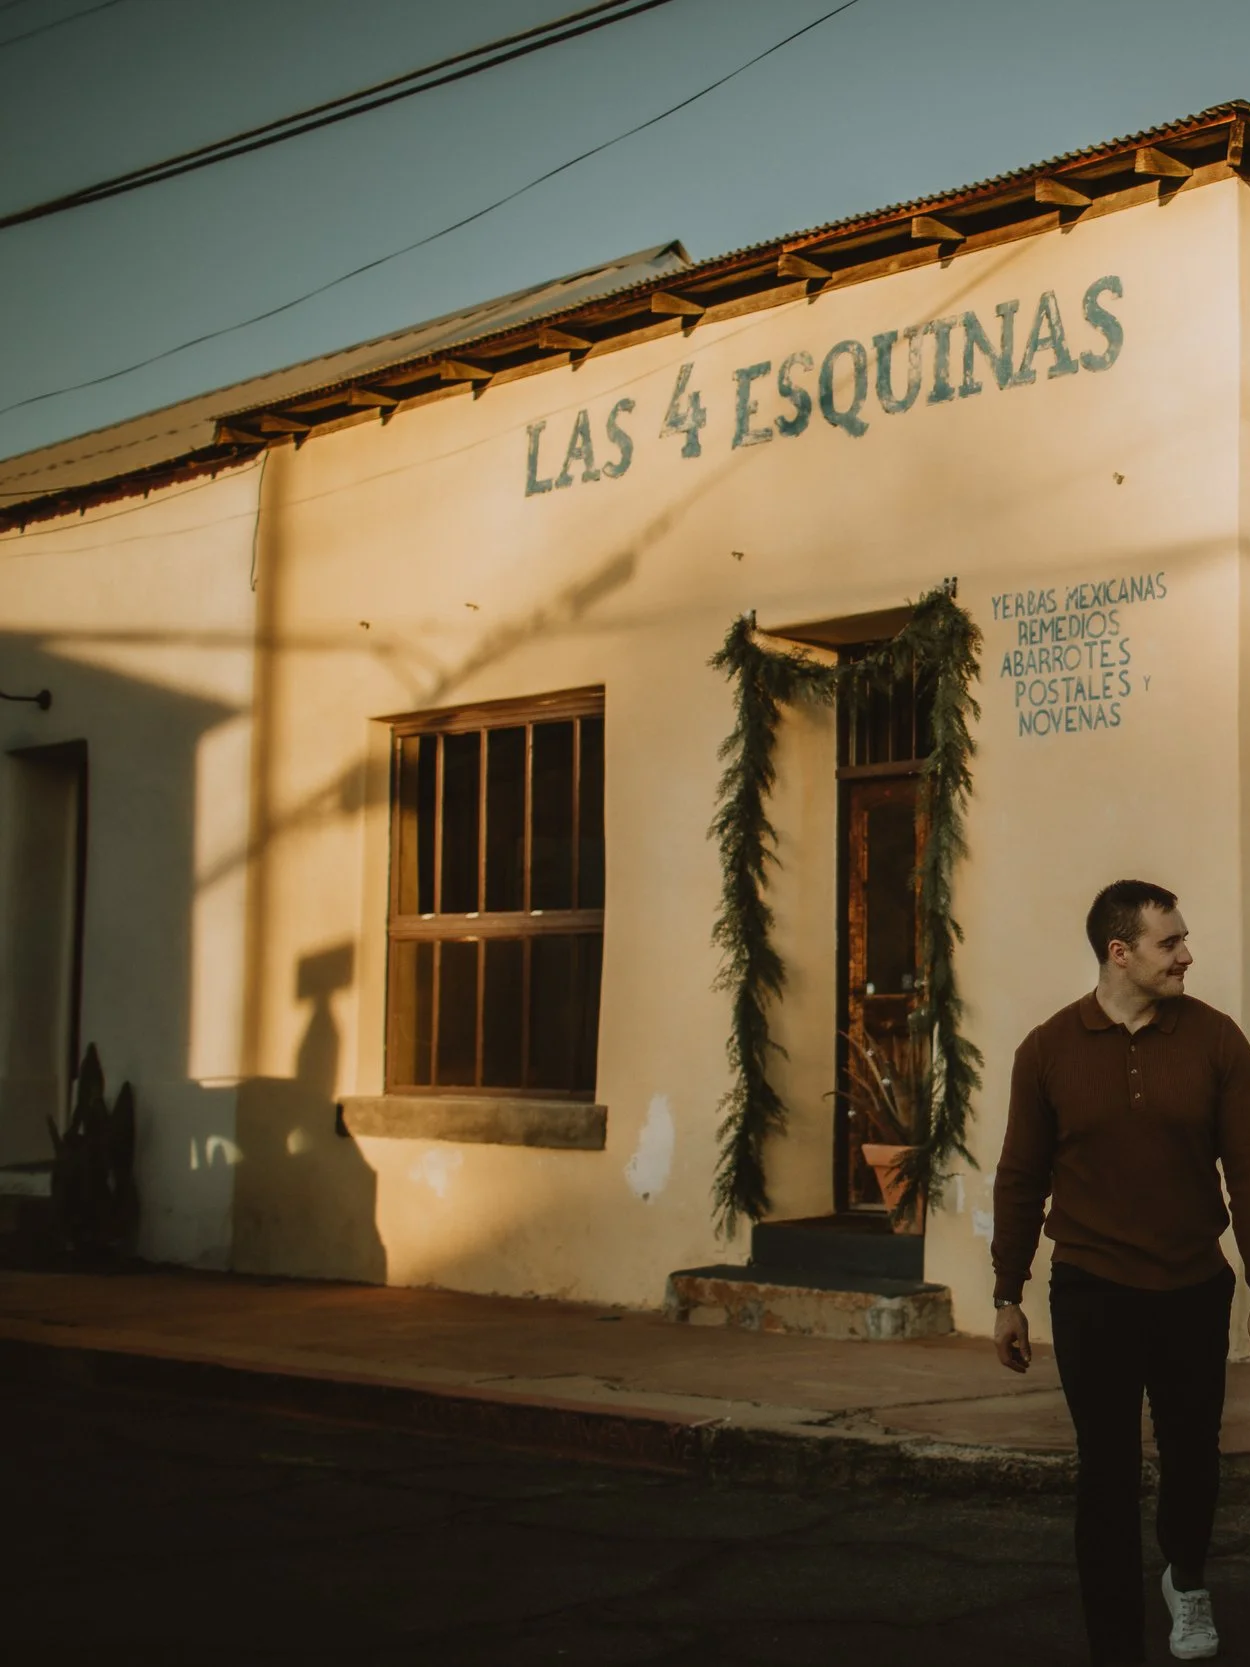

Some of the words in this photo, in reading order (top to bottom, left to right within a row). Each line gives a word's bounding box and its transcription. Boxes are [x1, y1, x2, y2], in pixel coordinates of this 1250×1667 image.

[524, 397, 637, 498] LAS
[659, 362, 707, 459] 4
[731, 275, 1124, 450] ESQUINAS
[991, 588, 1057, 620] YERBAS
[1065, 571, 1167, 611] MEXICANAS
[1018, 608, 1120, 646] REMEDIOS
[1000, 637, 1131, 678] ABARROTES
[1015, 669, 1131, 708] POSTALES
[1143, 675, 1151, 692] Y
[1019, 702, 1121, 737] NOVENAS
